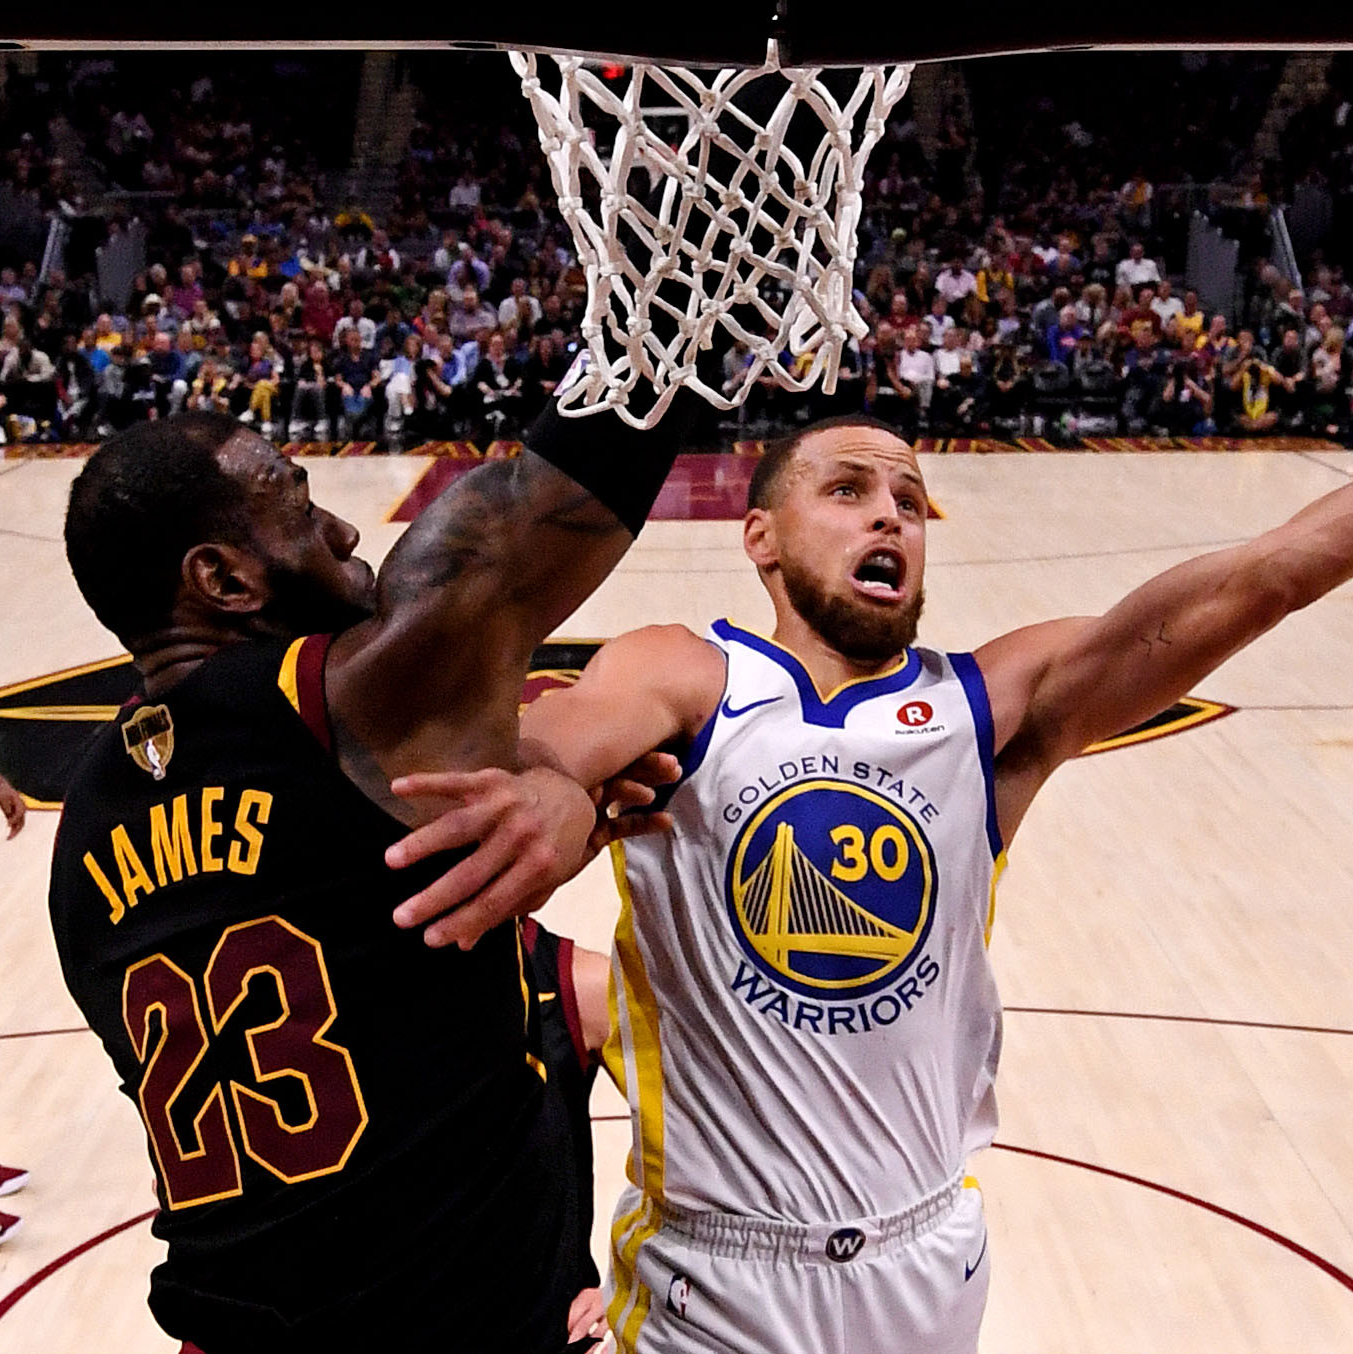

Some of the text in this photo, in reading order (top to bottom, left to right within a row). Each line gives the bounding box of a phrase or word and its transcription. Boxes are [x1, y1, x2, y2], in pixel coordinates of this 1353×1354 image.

[723, 755, 941, 825] GOLDEN STATE
[84, 786, 273, 925] JAMES
[829, 823, 909, 882] 30
[730, 952, 941, 1036] WARRIORS
[122, 914, 369, 1211] 23
[832, 1234, 862, 1256] W
